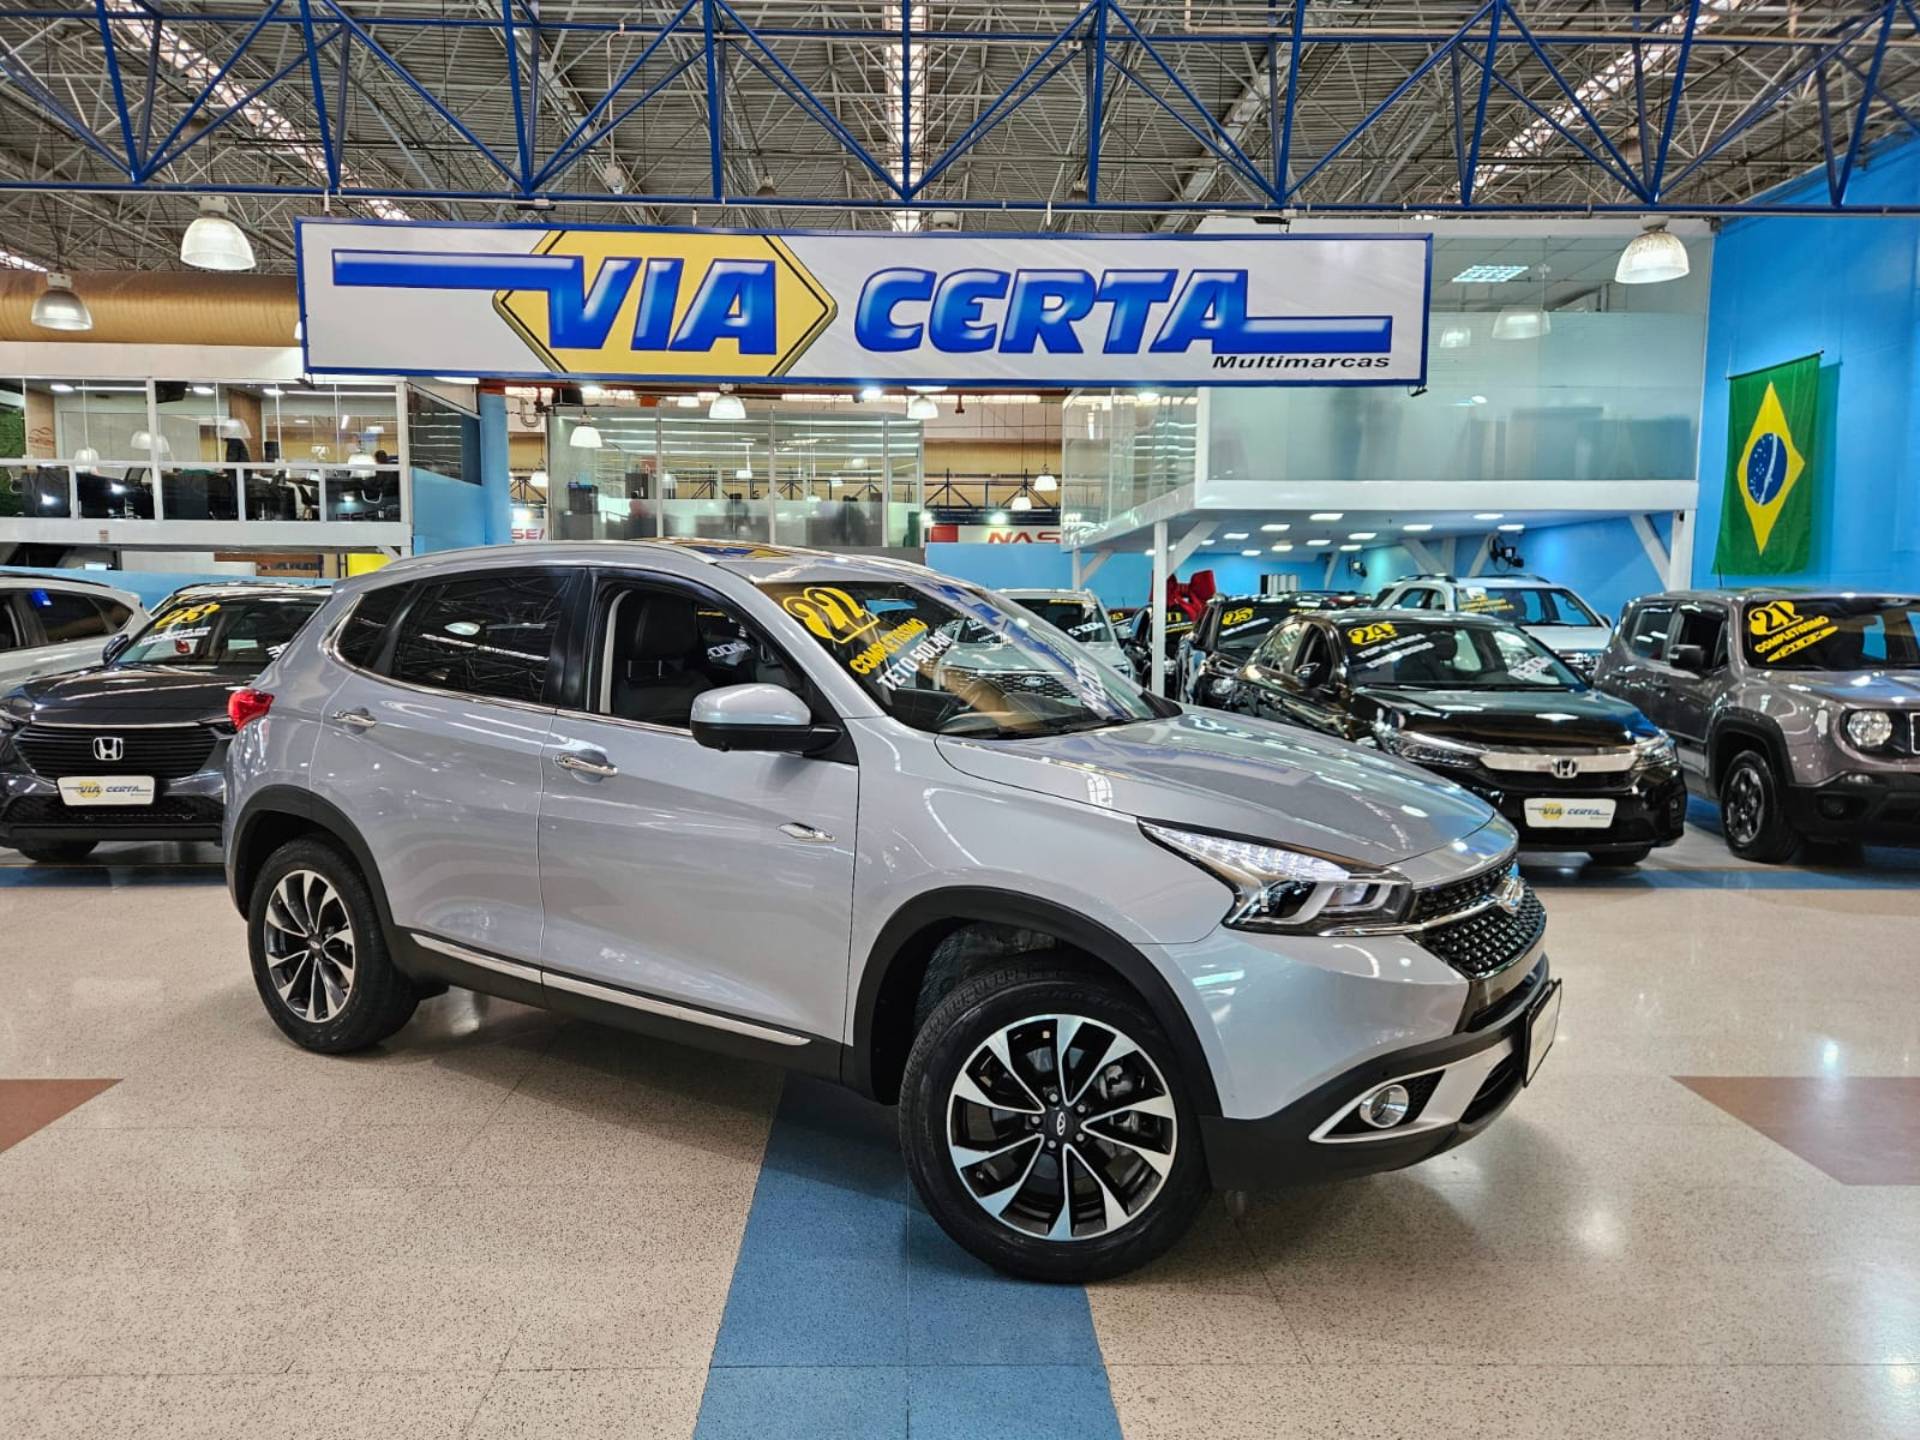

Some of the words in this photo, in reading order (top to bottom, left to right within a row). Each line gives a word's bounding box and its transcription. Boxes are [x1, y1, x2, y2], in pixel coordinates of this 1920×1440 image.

[549, 255, 777, 355] VIA
[854, 267, 1249, 354] CERTA
[1212, 354, 1391, 370] Multimarcas
[1347, 622, 1398, 646] 24
[1748, 600, 1804, 635] 21
[876, 657, 920, 691] TETO
[909, 630, 954, 664] SOLAR
